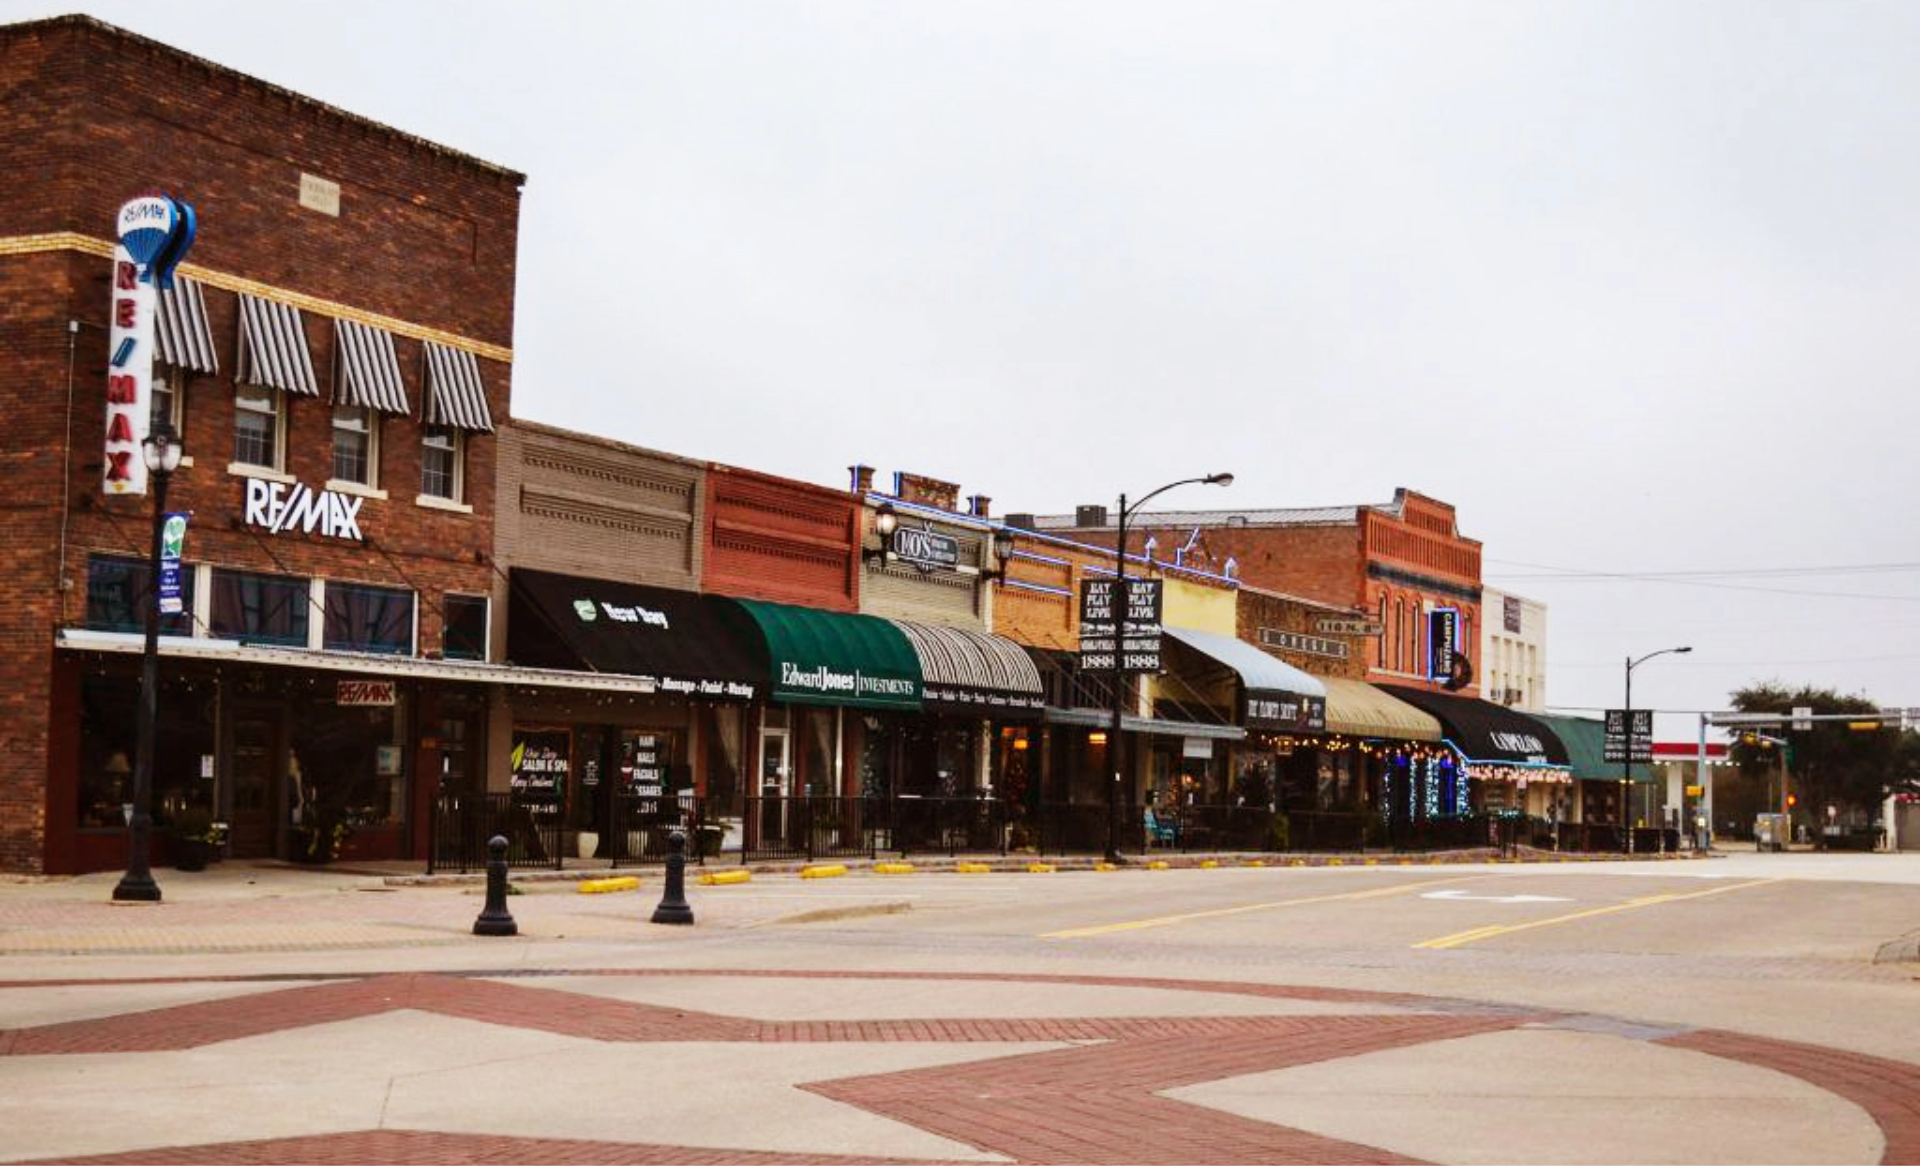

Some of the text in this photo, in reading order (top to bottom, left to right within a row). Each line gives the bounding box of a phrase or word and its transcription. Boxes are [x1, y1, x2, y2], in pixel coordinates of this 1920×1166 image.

[106, 261, 137, 481] RE/MAX
[245, 478, 364, 541] RE/MAX
[900, 530, 932, 559] MO'S
[1090, 583, 1111, 594] EAT
[1132, 583, 1154, 594] EAT
[1087, 594, 1112, 606] PLAY
[1128, 594, 1156, 605] PLAY
[1086, 607, 1111, 618] LIVE
[1128, 607, 1154, 618] LIVE
[860, 676, 914, 695] INVESTMENTS
[338, 682, 393, 703] RE/MAX
[522, 759, 547, 772] SALON
[555, 759, 567, 772] SPA
[633, 769, 659, 780] FACIALS
